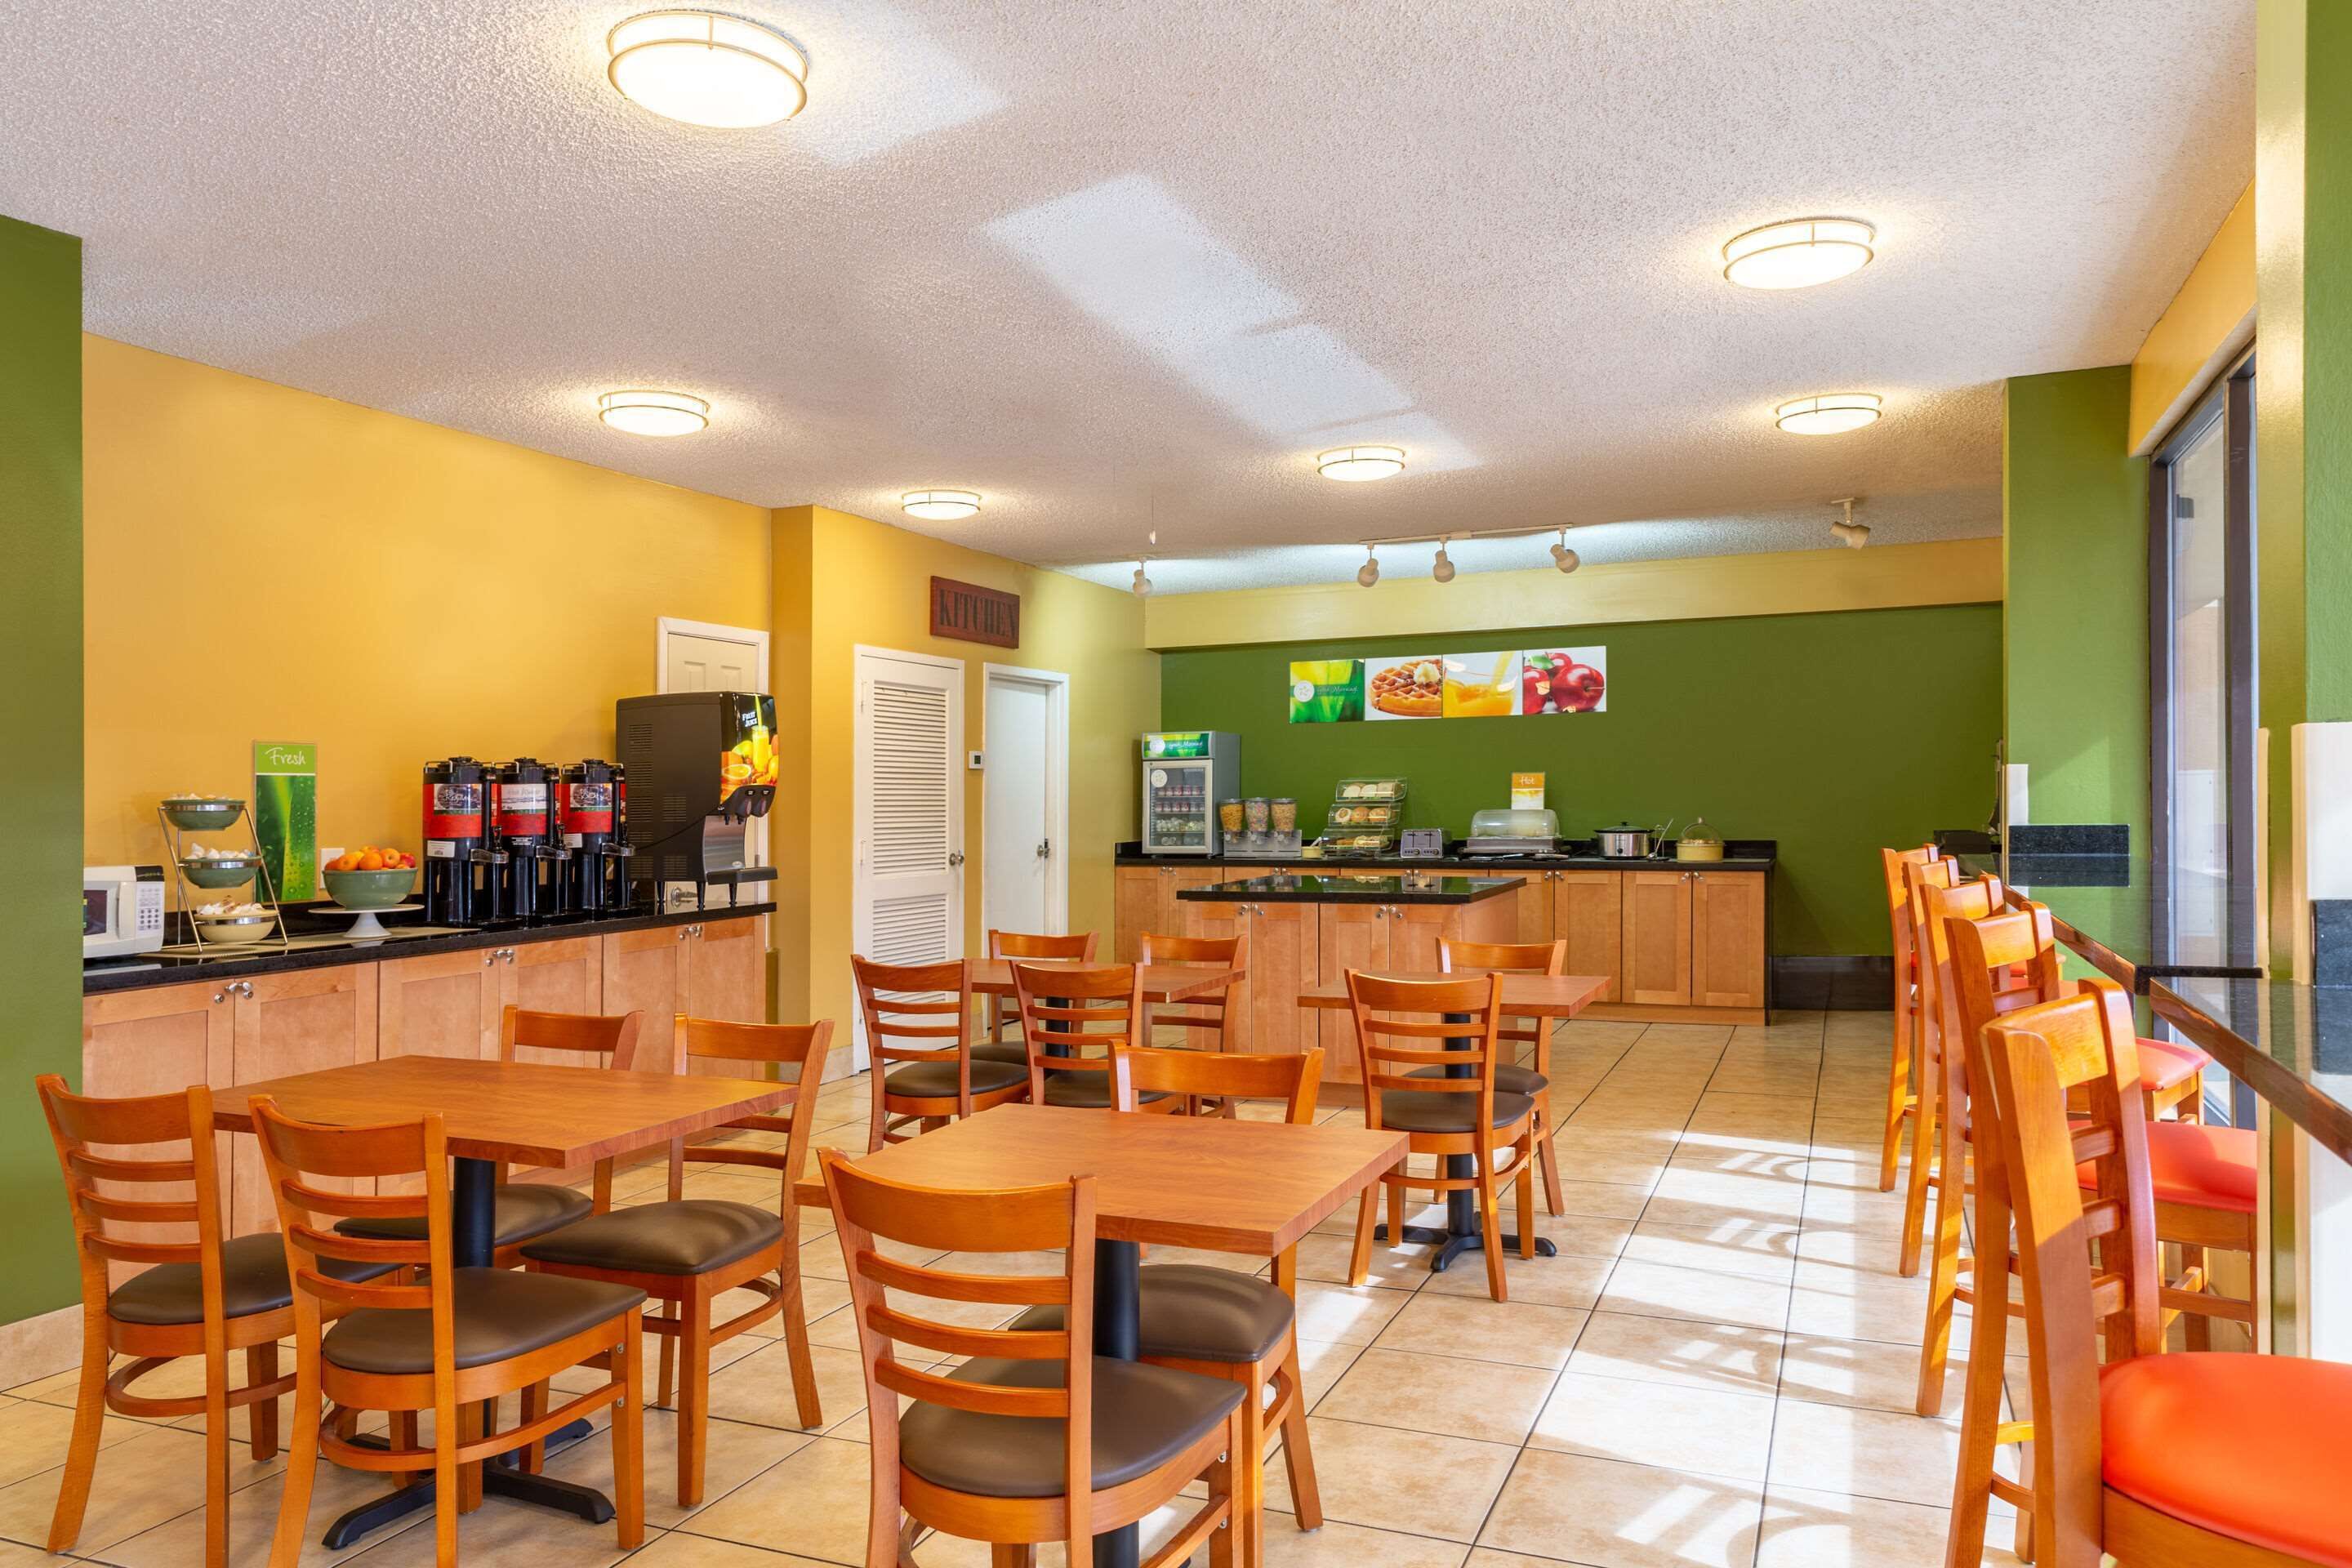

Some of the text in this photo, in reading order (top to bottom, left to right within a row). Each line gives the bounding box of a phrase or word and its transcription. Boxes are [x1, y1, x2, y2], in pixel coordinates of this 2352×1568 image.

[939, 588, 1017, 640] KITCHEN
[265, 746, 306, 765] Fresh
[1521, 777, 1535, 786] Hot
